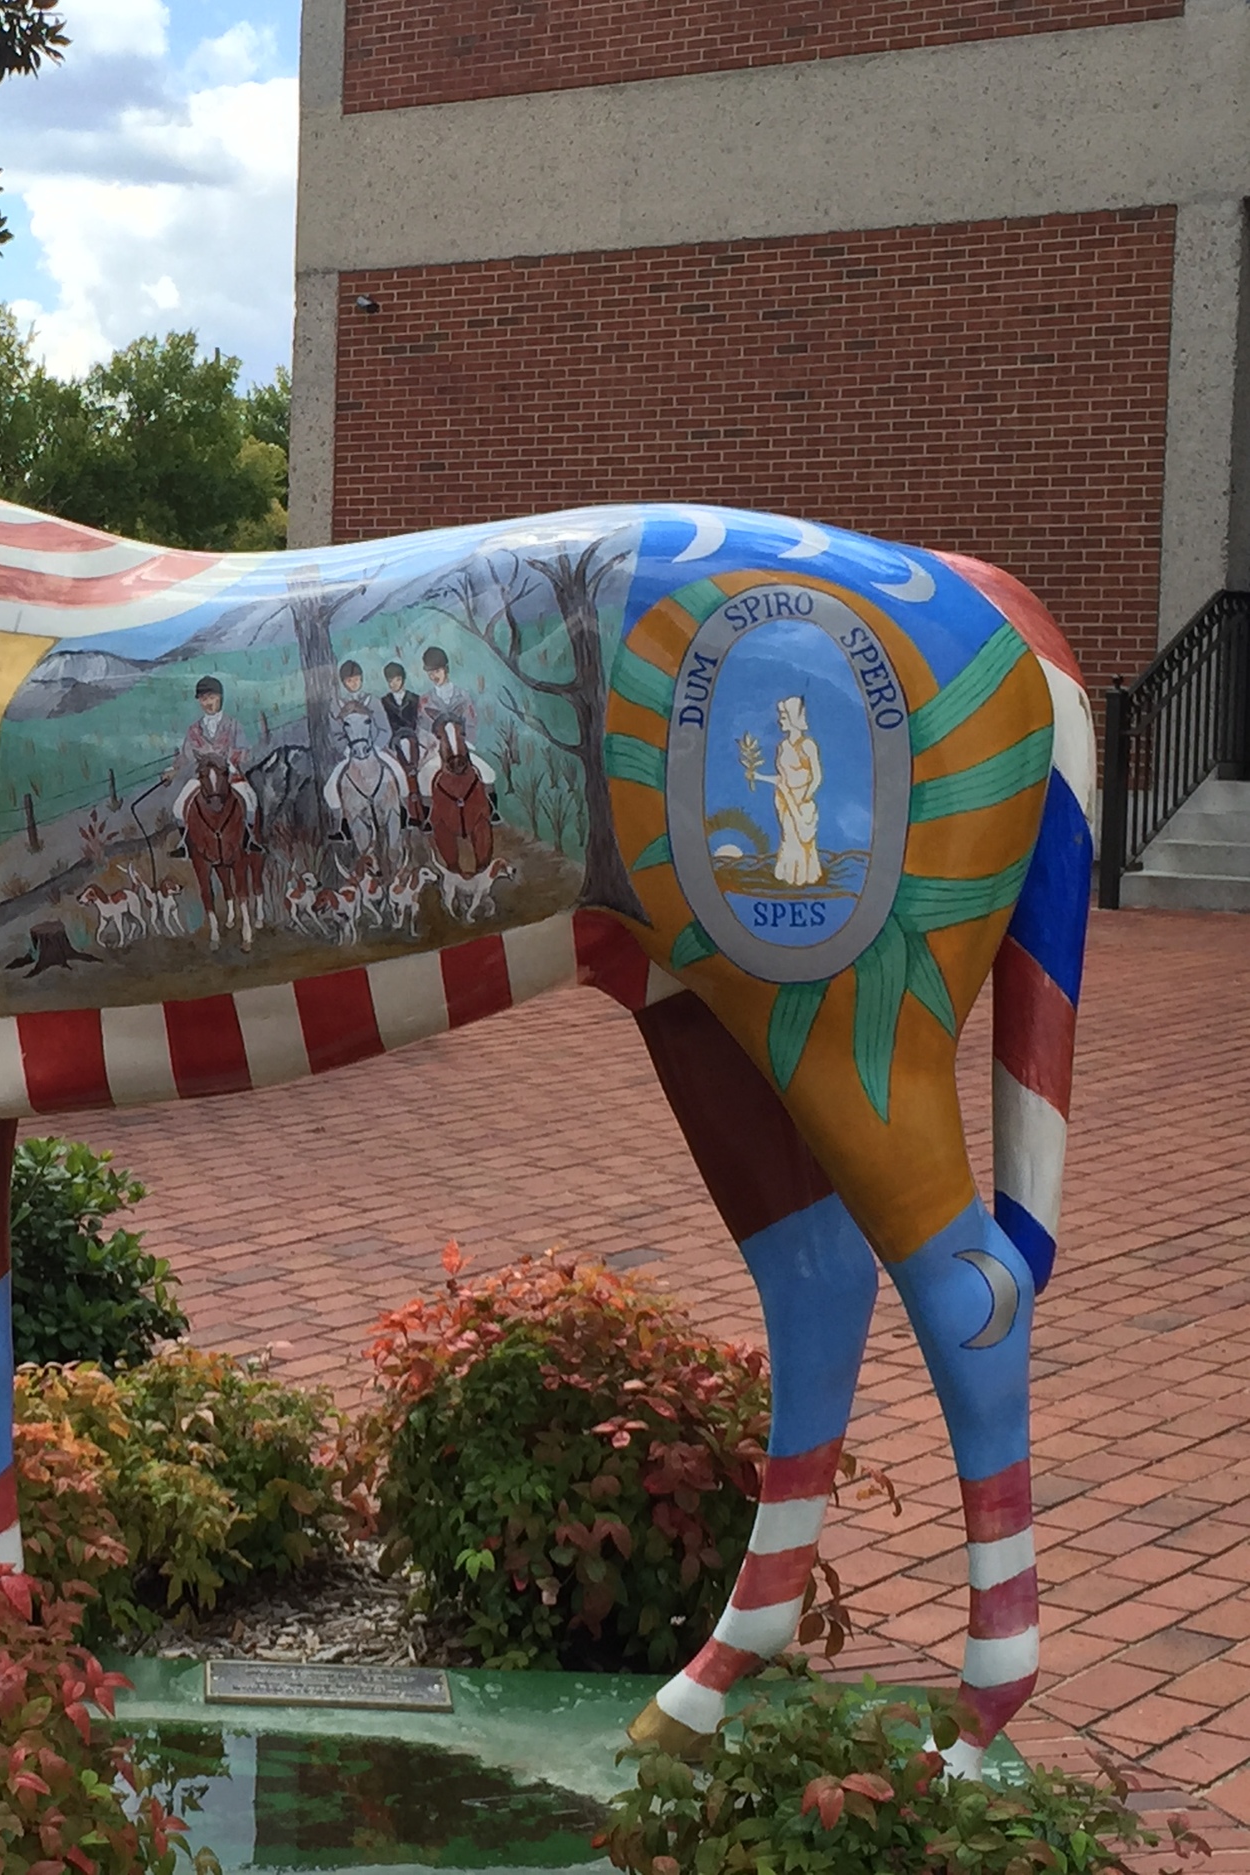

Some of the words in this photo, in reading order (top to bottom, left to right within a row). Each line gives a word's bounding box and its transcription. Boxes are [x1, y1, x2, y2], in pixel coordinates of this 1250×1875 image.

[679, 652, 718, 729] DUM
[724, 591, 814, 631] SPIRO
[840, 627, 904, 730] SPERO
[753, 901, 826, 928] SPES
